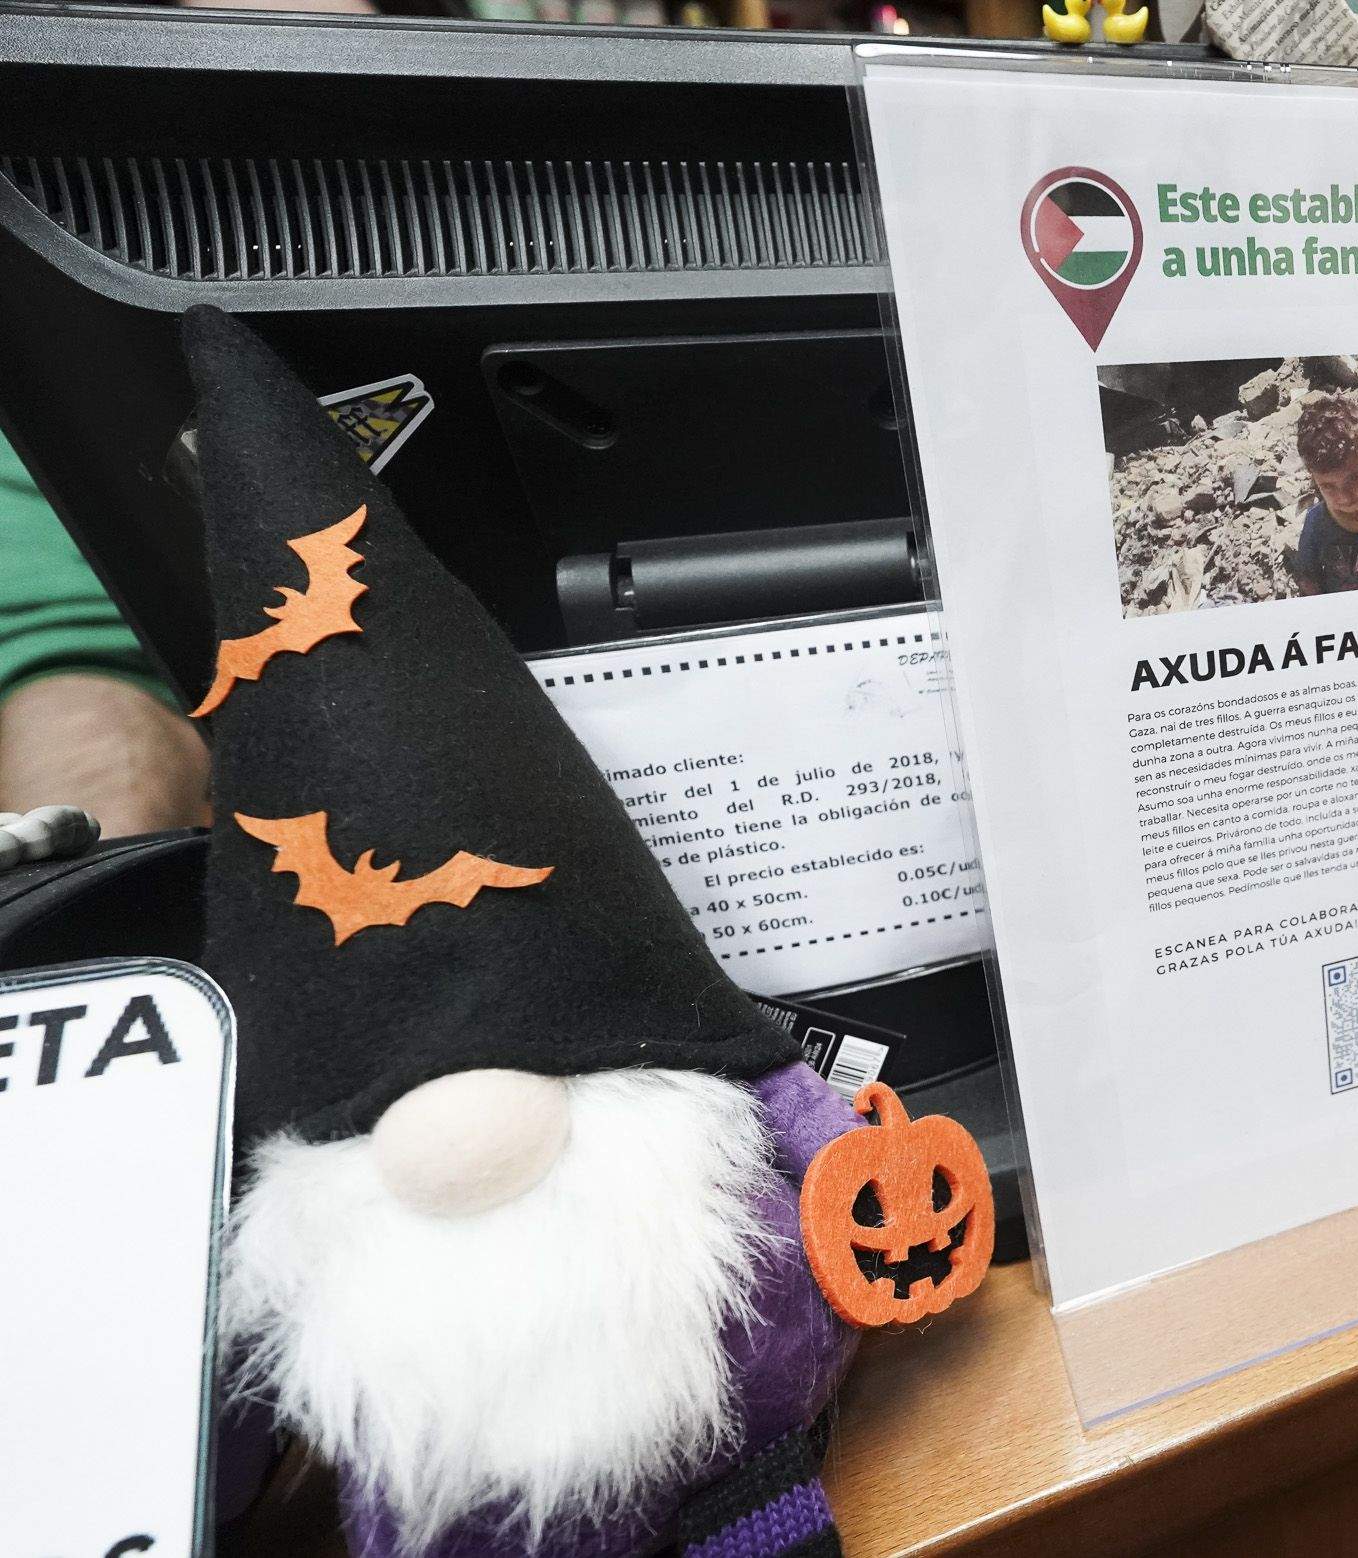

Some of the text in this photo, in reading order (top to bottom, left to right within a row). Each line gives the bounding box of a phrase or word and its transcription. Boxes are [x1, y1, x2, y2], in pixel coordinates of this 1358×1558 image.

[1157, 184, 1242, 223] Este
[1163, 245, 1186, 278] a
[1196, 237, 1294, 277] unha
[1130, 643, 1274, 692] AXUDA
[1280, 632, 1312, 669] Á
[1127, 712, 1153, 723] Para
[1217, 692, 1280, 709] bondadosos
[1160, 721, 1177, 733] nai
[1194, 717, 1216, 727] tres
[1130, 732, 1217, 754] completamente
[1284, 716, 1313, 727] meus
[1313, 712, 1337, 723] fillos
[1132, 755, 1168, 769] dunha
[1169, 751, 1196, 762] zona
[1237, 739, 1268, 751] Agora
[1268, 732, 1306, 745] vivimos
[603, 754, 745, 782] imado cliente:
[622, 789, 668, 808] artir
[684, 783, 714, 800] del
[730, 780, 741, 793] 1
[757, 775, 780, 789] de
[795, 767, 837, 787] julio
[851, 761, 874, 776] de
[889, 752, 940, 770] 2018,
[1134, 773, 1154, 784] sen
[1168, 759, 1233, 777] necesidades
[1279, 747, 1302, 759] para
[1203, 775, 1228, 785] meu
[1229, 770, 1256, 781] fogar
[1306, 755, 1333, 767] onde
[632, 772, 942, 828] miento del R.D. 293/2018,
[1137, 799, 1176, 813] Asumo
[1176, 795, 1195, 806] soa
[1196, 790, 1224, 802] unha
[1224, 782, 1266, 796] enorme
[1186, 803, 1231, 818] Necesita
[1231, 795, 1275, 810] operarse
[1276, 791, 1294, 803] por
[1309, 783, 1335, 794] corte
[644, 824, 725, 849] cimiento
[734, 819, 783, 836] tiene
[791, 814, 809, 827] la
[818, 799, 911, 823] obligación
[920, 794, 942, 808] de
[1141, 829, 1171, 842] meus
[1172, 824, 1197, 835] fillos
[1212, 815, 1243, 828] canto
[678, 852, 702, 866] de
[707, 841, 786, 865] plástico.
[704, 845, 925, 889] El precio establecido es:
[1142, 845, 1166, 857] leite
[1144, 859, 1168, 873] para
[1169, 851, 1206, 865] ofrecer
[1243, 837, 1277, 850] familia
[1278, 831, 1304, 843] unha
[1145, 872, 1176, 885] meus
[1176, 867, 1201, 878] fillos
[1202, 861, 1226, 875] polo
[1226, 857, 1247, 868] que
[1260, 851, 1278, 860] lles
[1147, 883, 1194, 901] pequena
[1195, 878, 1216, 889] que
[1242, 864, 1269, 878] Pode
[1270, 863, 1285, 873] ser
[1148, 901, 1174, 913] fillos
[1282, 873, 1303, 884] que
[1303, 869, 1321, 879] lles
[1320, 863, 1349, 875] tenda
[706, 899, 731, 914] 40
[736, 899, 747, 911] x
[752, 890, 809, 908] 50cm.
[712, 925, 737, 940] 50
[741, 925, 753, 936] x
[758, 916, 814, 933] 60cm.
[1154, 933, 1228, 959] ESCANEA
[1233, 922, 1274, 940] PARA
[1156, 919, 1358, 975] GRAZAS POLA TÚA AXUDA!
